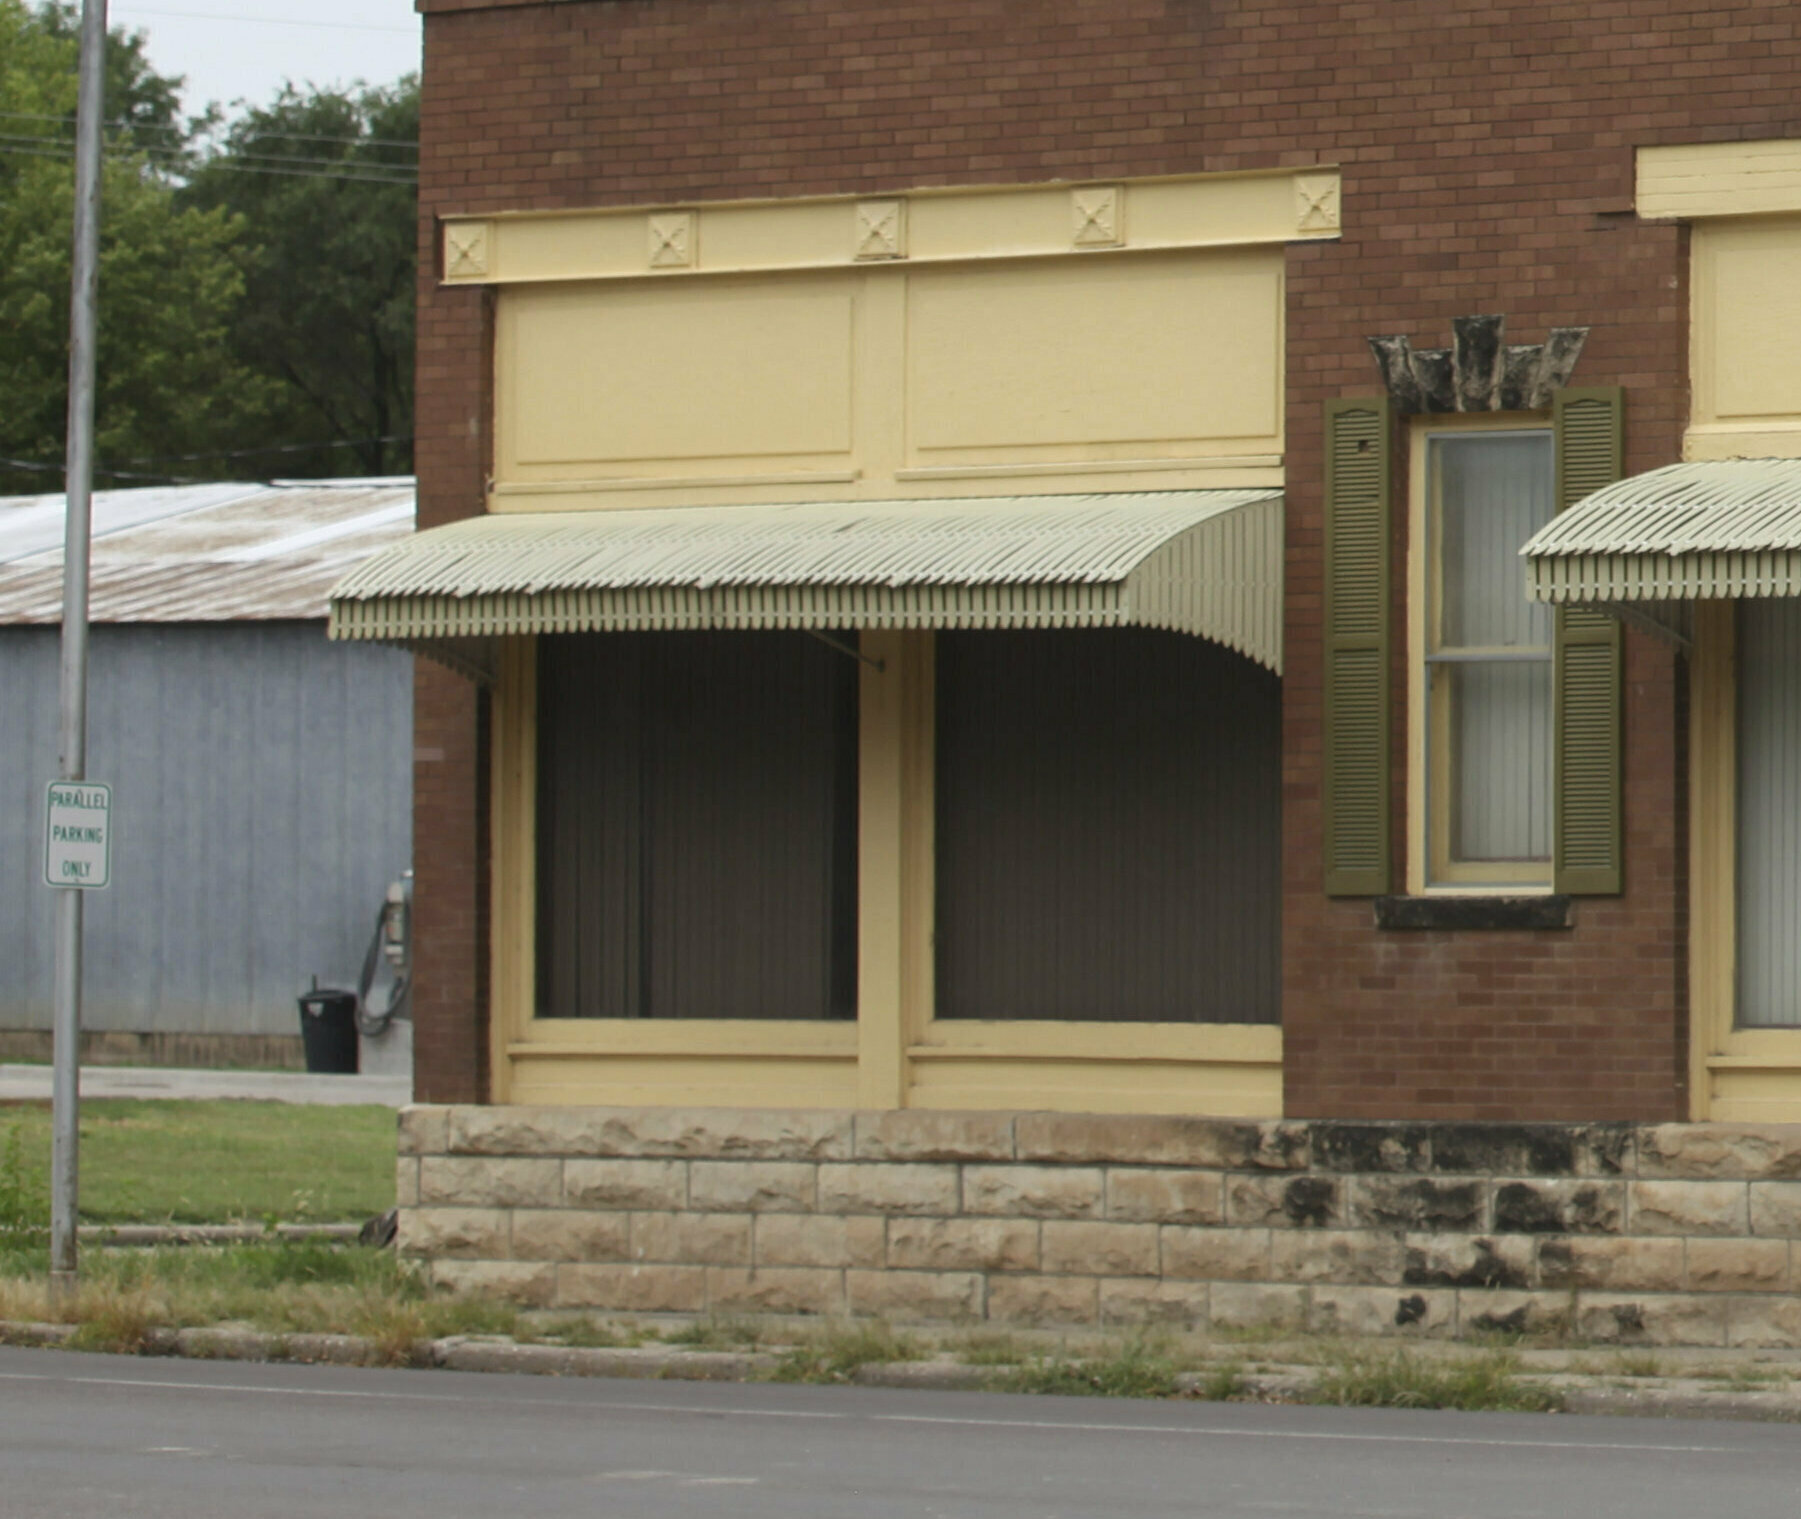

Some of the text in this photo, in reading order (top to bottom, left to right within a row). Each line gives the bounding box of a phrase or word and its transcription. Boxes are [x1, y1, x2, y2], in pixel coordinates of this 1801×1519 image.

[51, 791, 107, 810] PARALLEL
[53, 825, 102, 843] PARKING
[62, 860, 91, 877] ONLY
